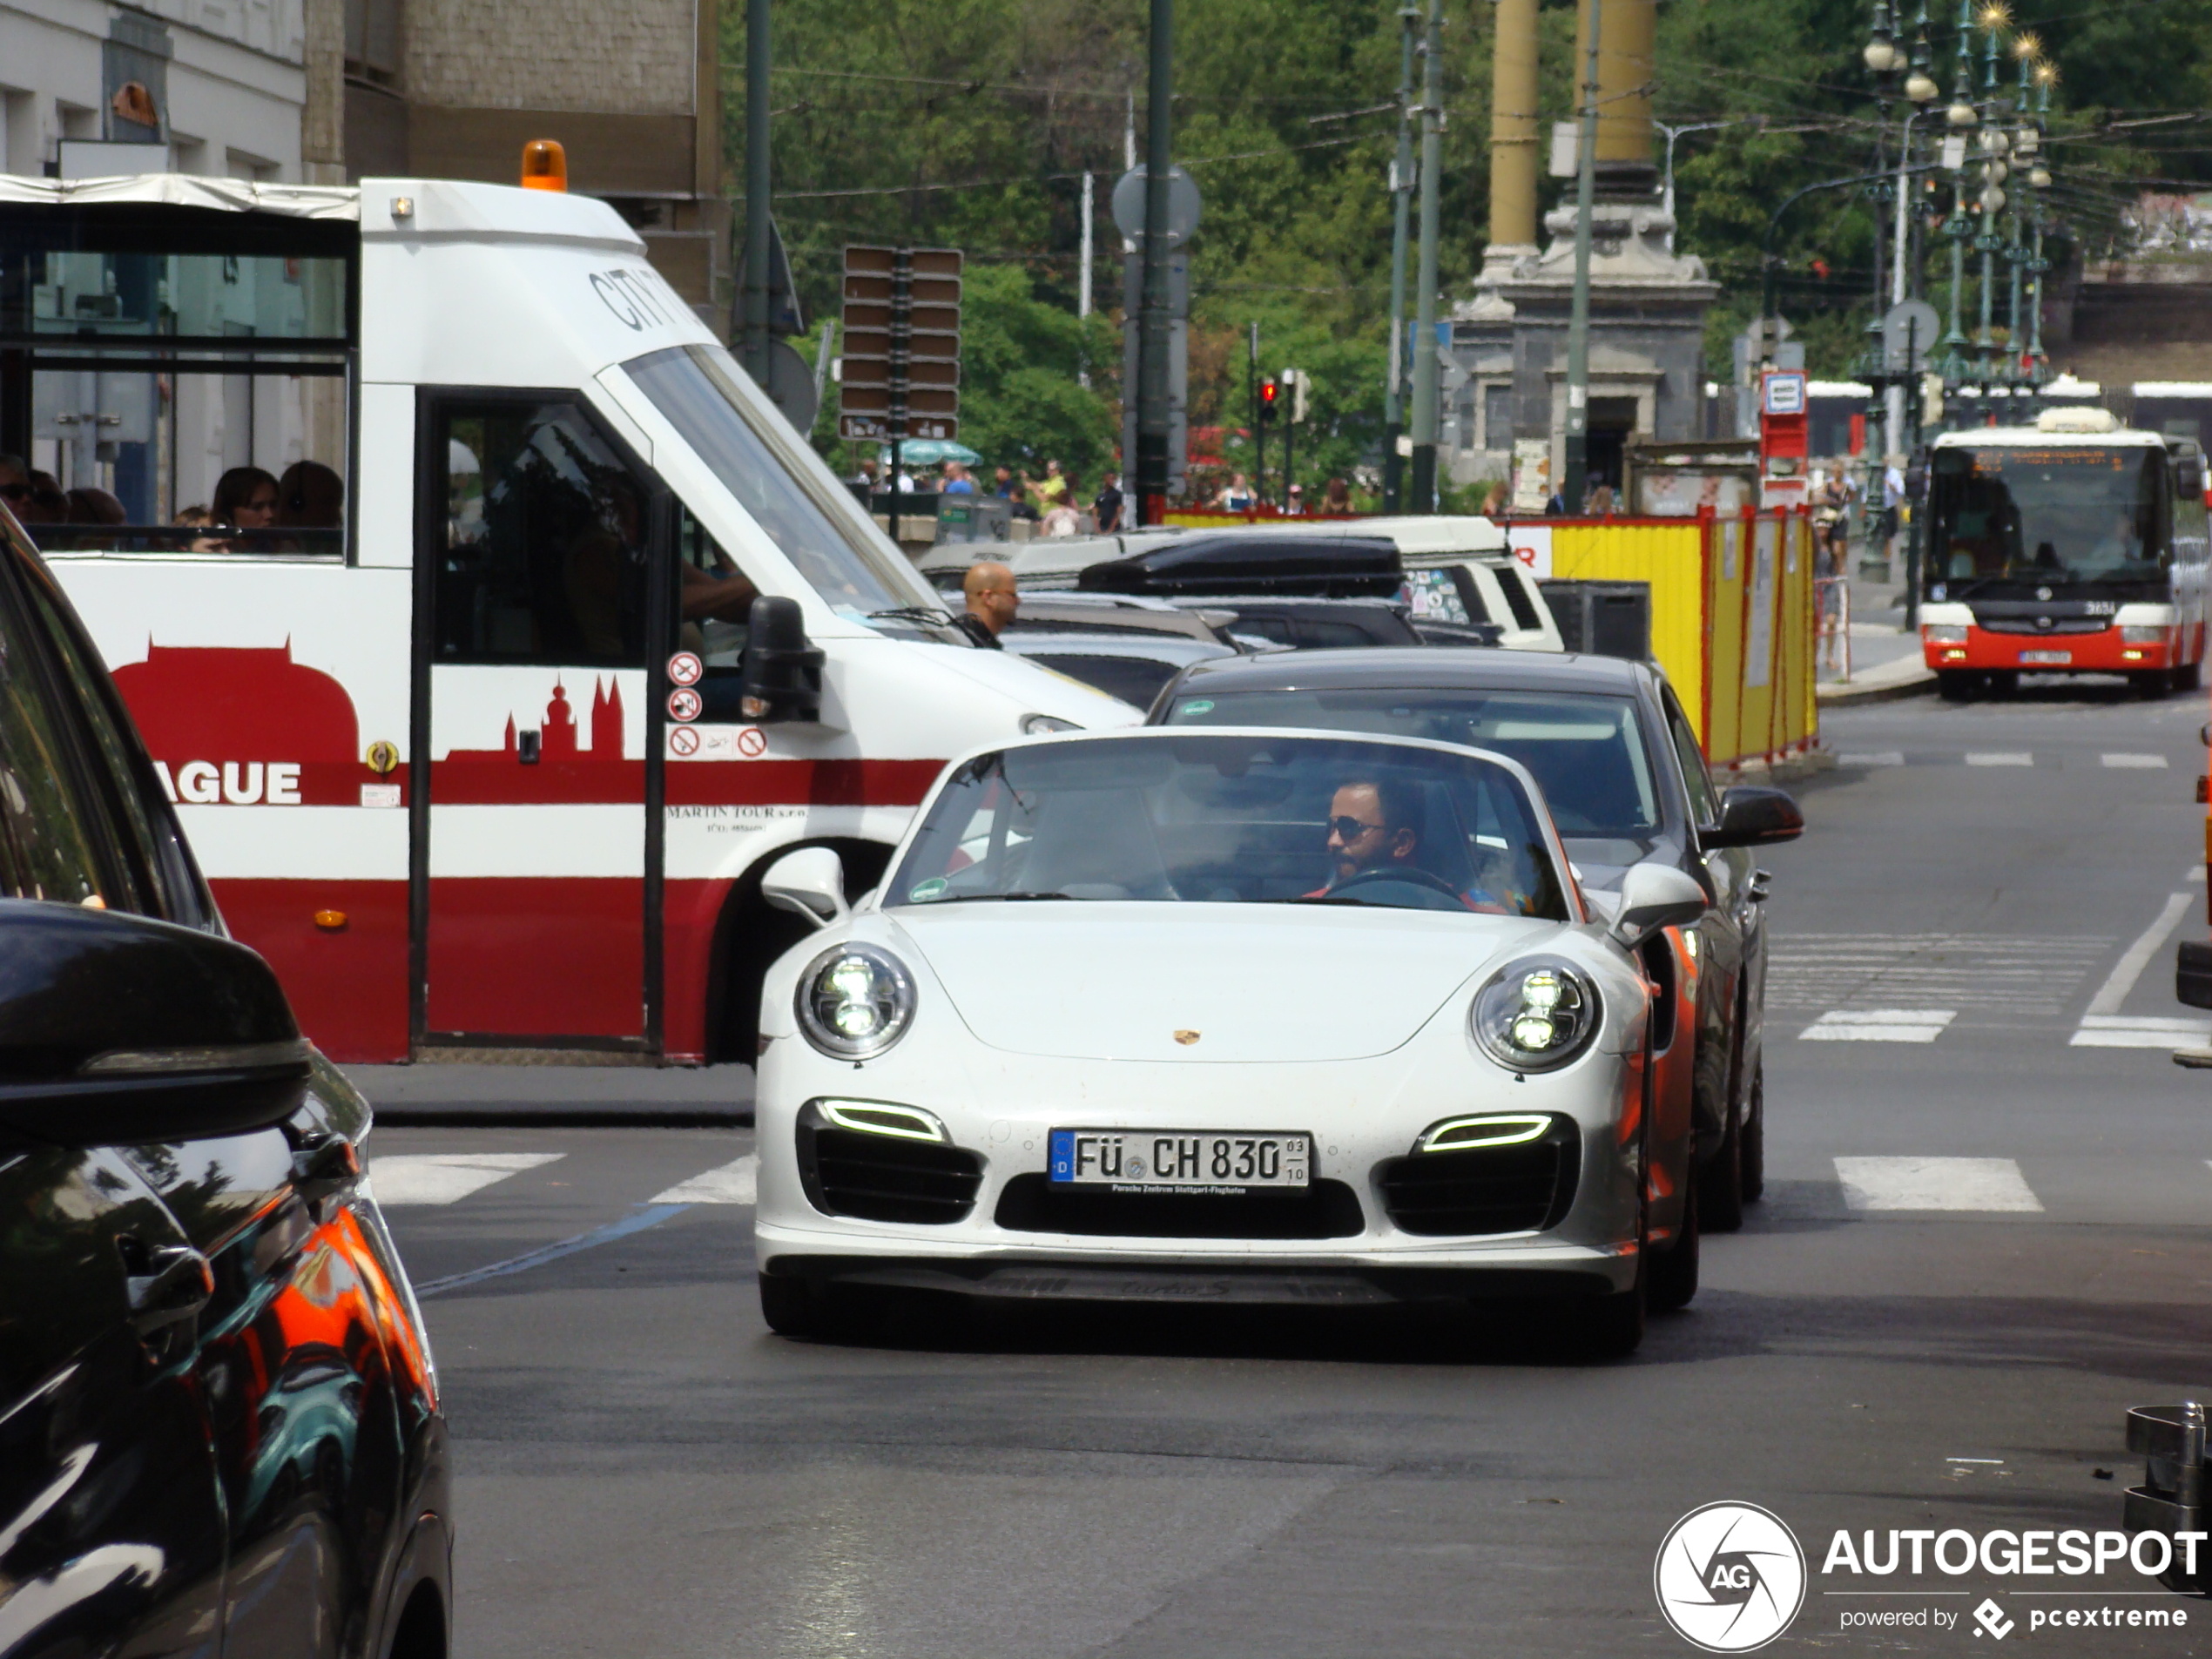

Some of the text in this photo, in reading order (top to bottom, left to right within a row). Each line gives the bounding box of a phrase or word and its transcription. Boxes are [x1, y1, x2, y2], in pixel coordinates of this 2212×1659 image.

[589, 268, 677, 332] CITY
[667, 806, 727, 819] MARTIN
[733, 806, 774, 819] TOUR
[1287, 1140, 1304, 1152] 03
[1076, 1136, 1279, 1178] FÜ CH 830
[1058, 1161, 1068, 1173] D
[1287, 1169, 1304, 1180] 10
[1112, 1184, 1246, 1195] Porsche Zentrum Stuttgart-Flughafen
